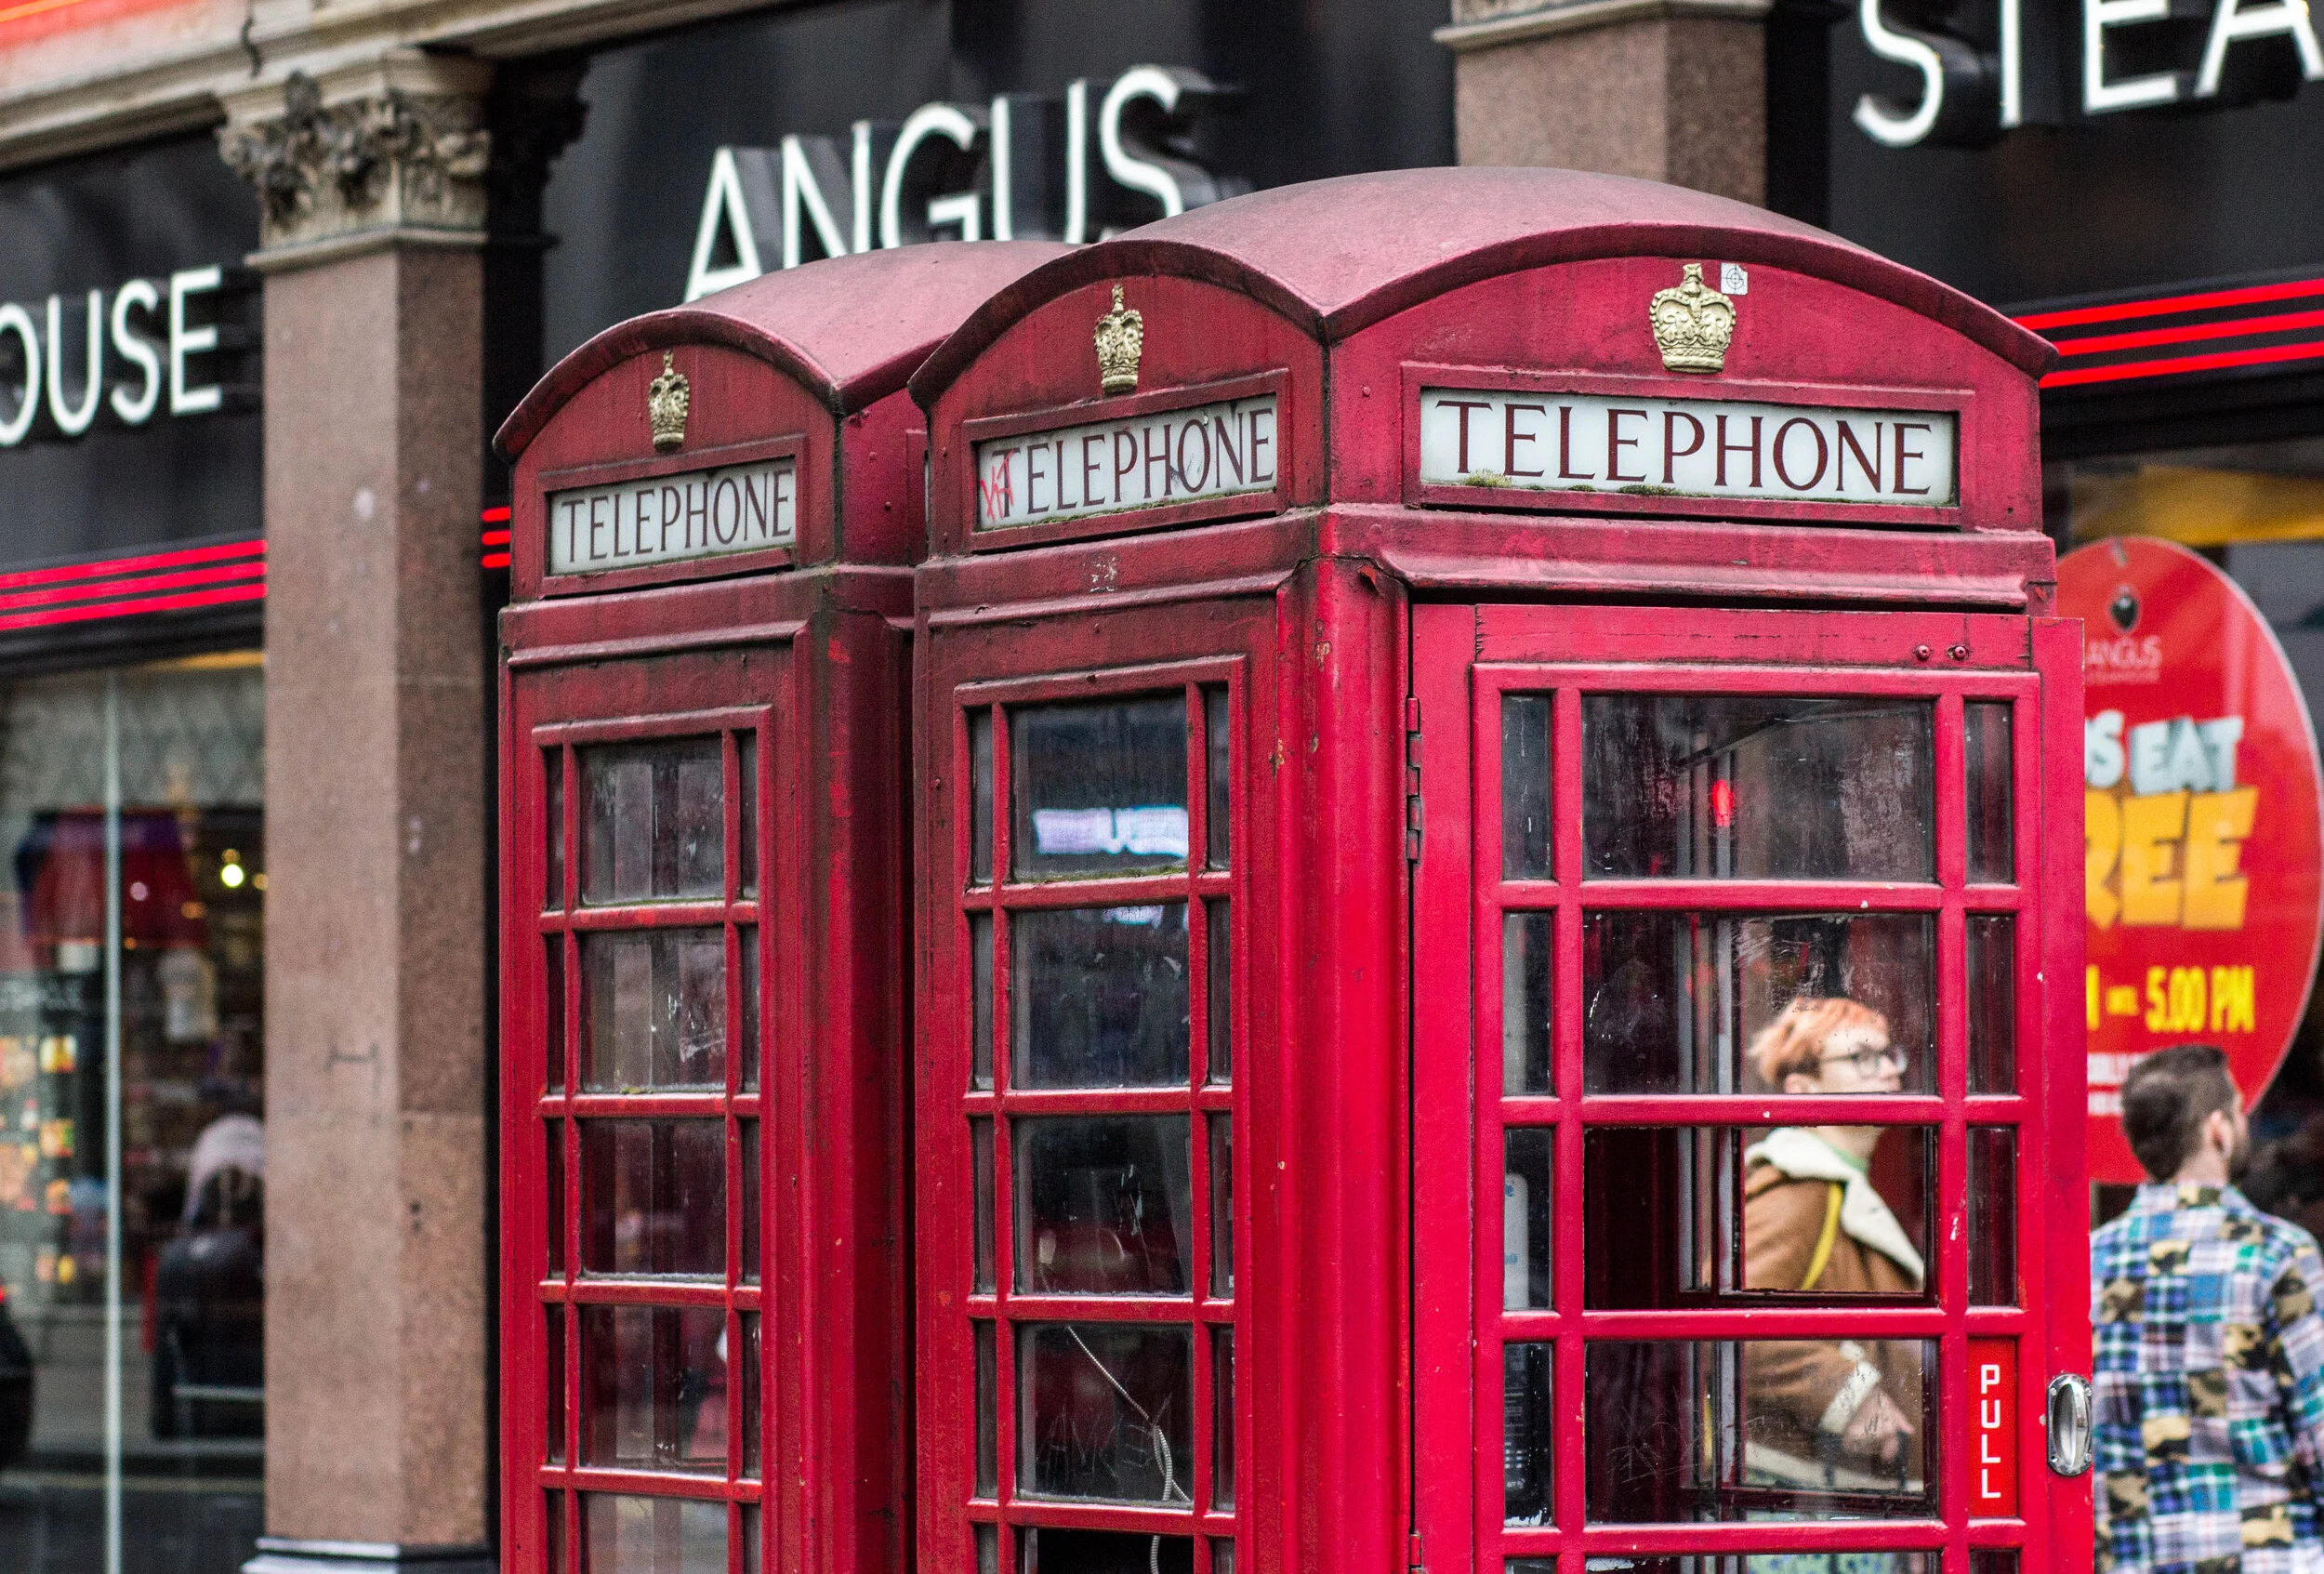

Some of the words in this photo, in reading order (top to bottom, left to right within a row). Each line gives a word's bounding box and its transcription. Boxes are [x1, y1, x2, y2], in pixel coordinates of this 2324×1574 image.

[684, 65, 1184, 304] ANGUS
[991, 407, 1274, 518] TELEPHONE
[1435, 398, 1934, 496] TELEPHONE
[561, 469, 793, 563] TELEPHONE
[2127, 714, 2245, 797] EAT
[2145, 964, 2207, 1034] 5.00
[2211, 964, 2256, 1034] PM
[1980, 1364, 2001, 1499] PULL
